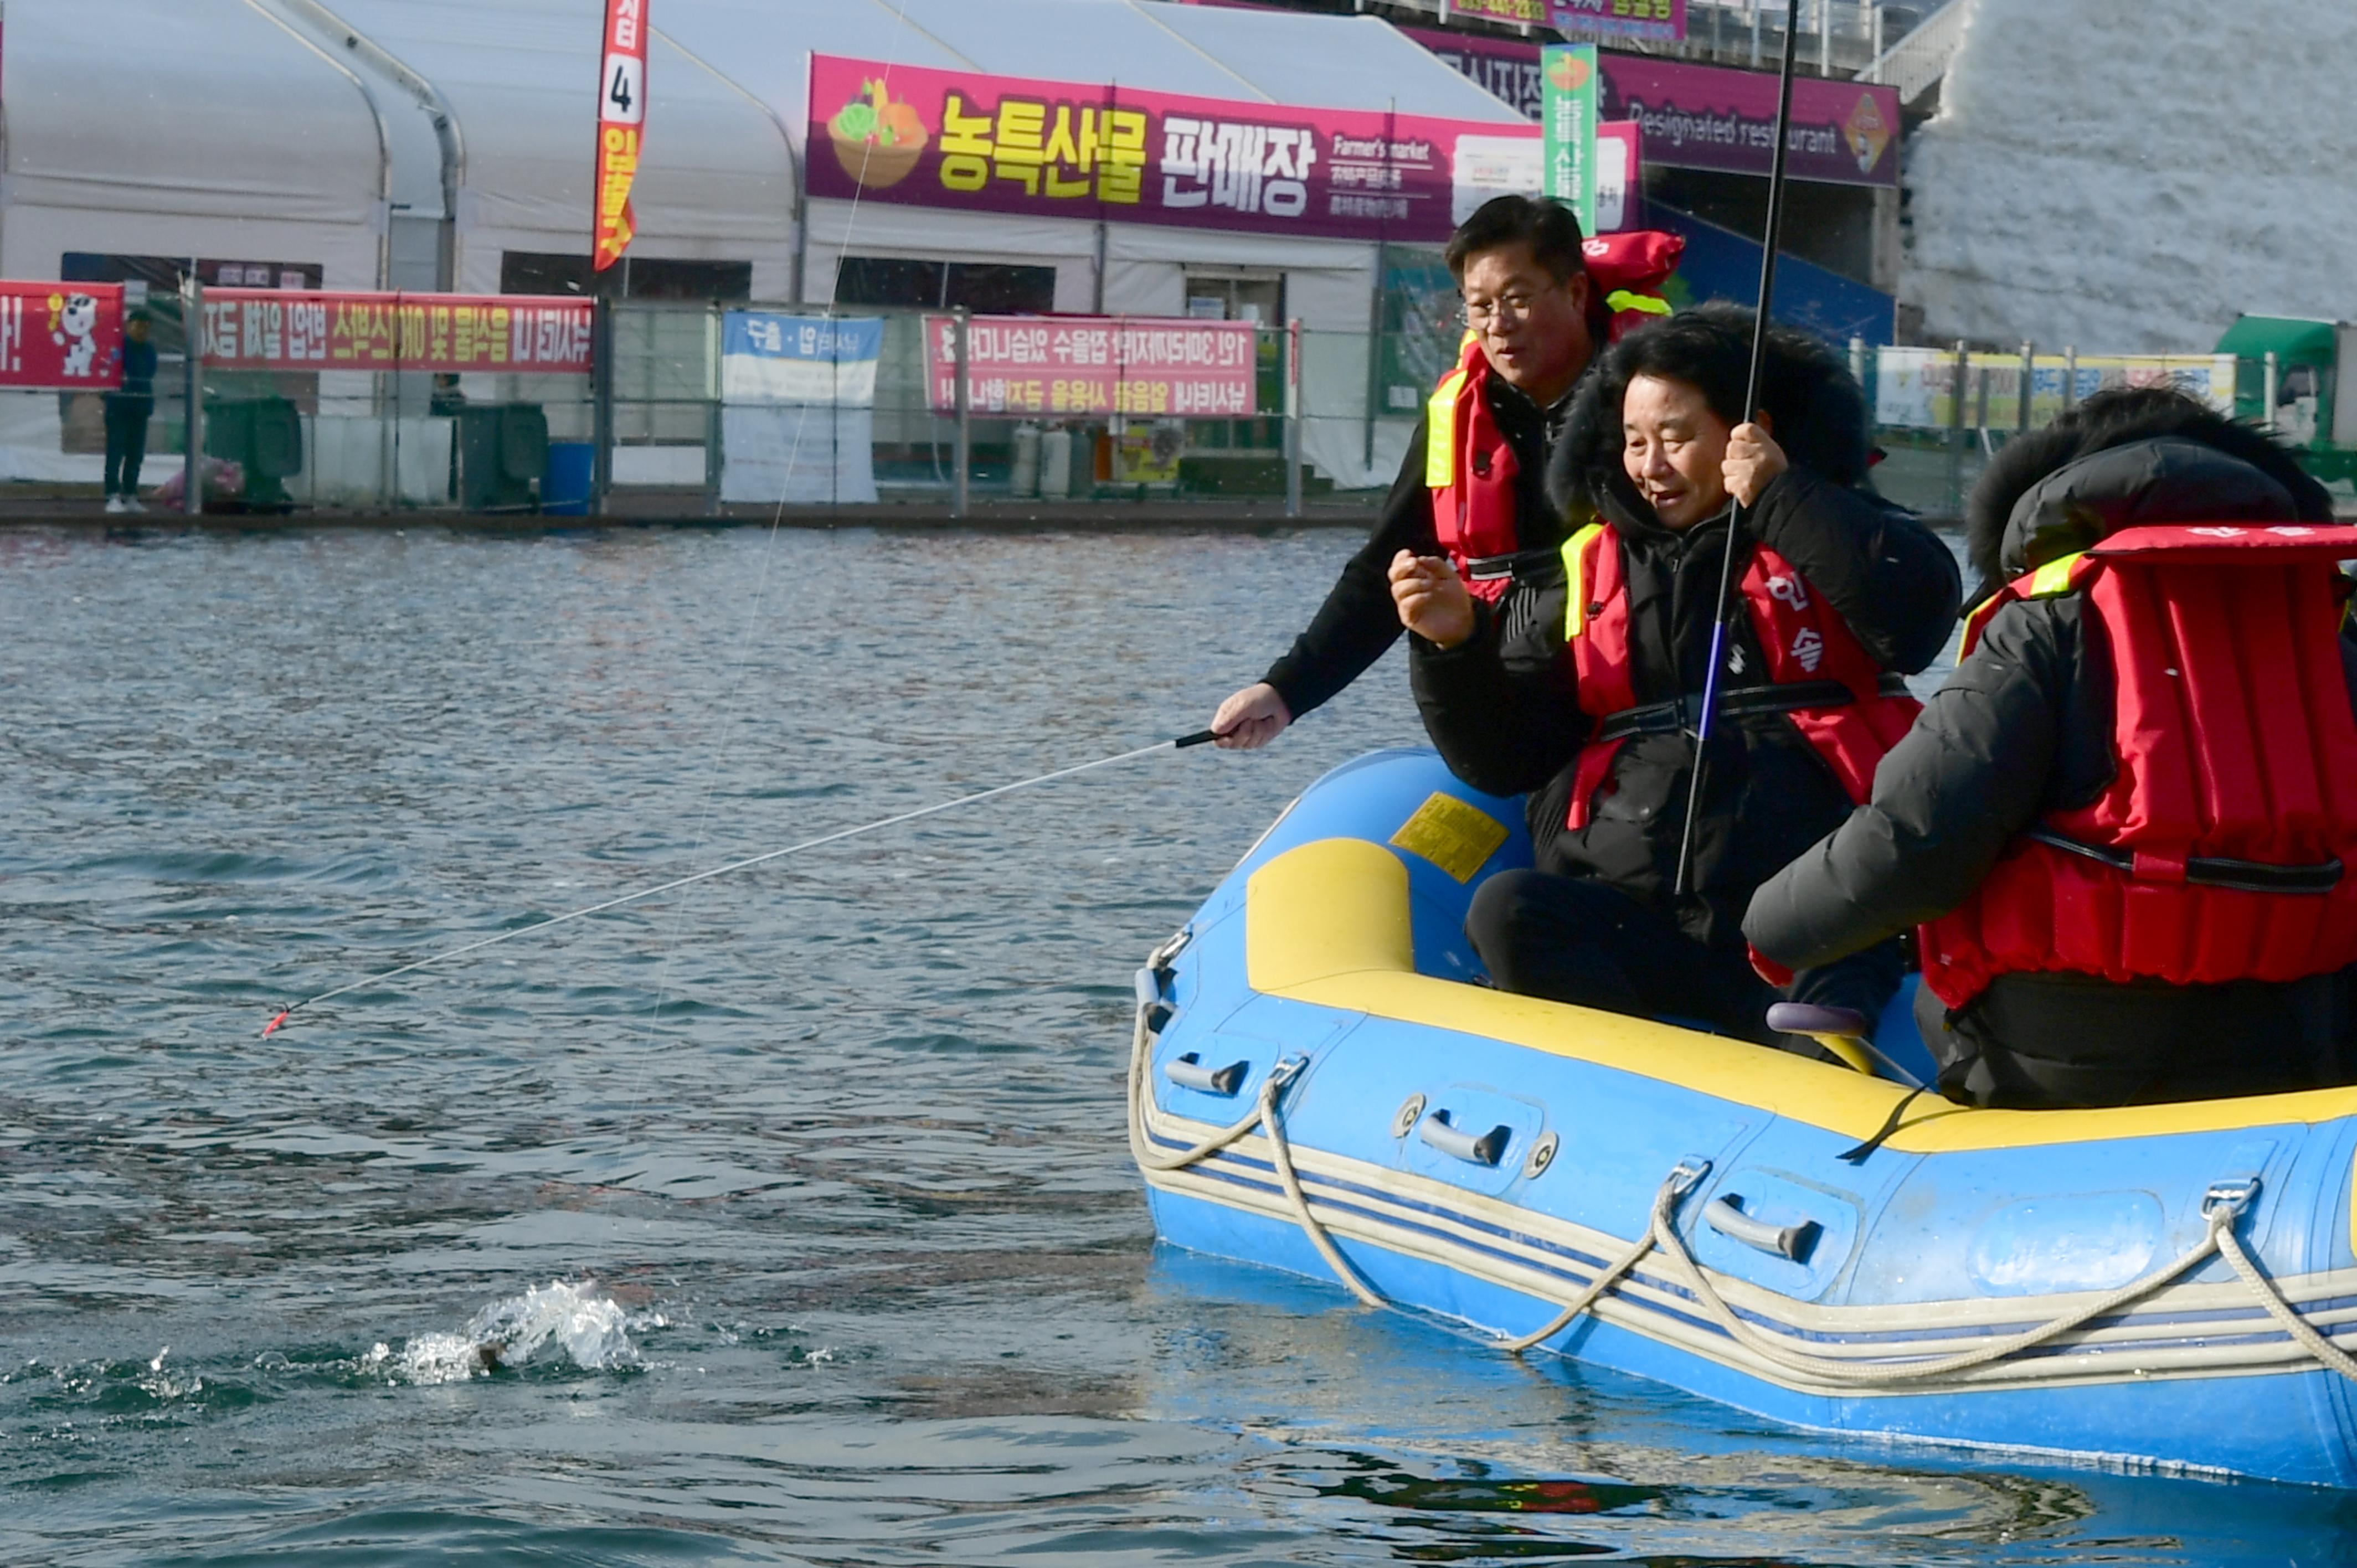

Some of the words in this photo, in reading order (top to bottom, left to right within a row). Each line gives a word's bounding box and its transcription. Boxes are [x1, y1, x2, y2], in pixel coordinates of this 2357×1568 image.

[610, 65, 632, 113] 4
[1333, 135, 1386, 158] Farmer's
[1389, 140, 1430, 160] market
[1628, 102, 1737, 147] Designated
[1740, 119, 1837, 154] resturant
[939, 96, 1147, 204] 농특산물
[1160, 117, 1317, 217] 판매장
